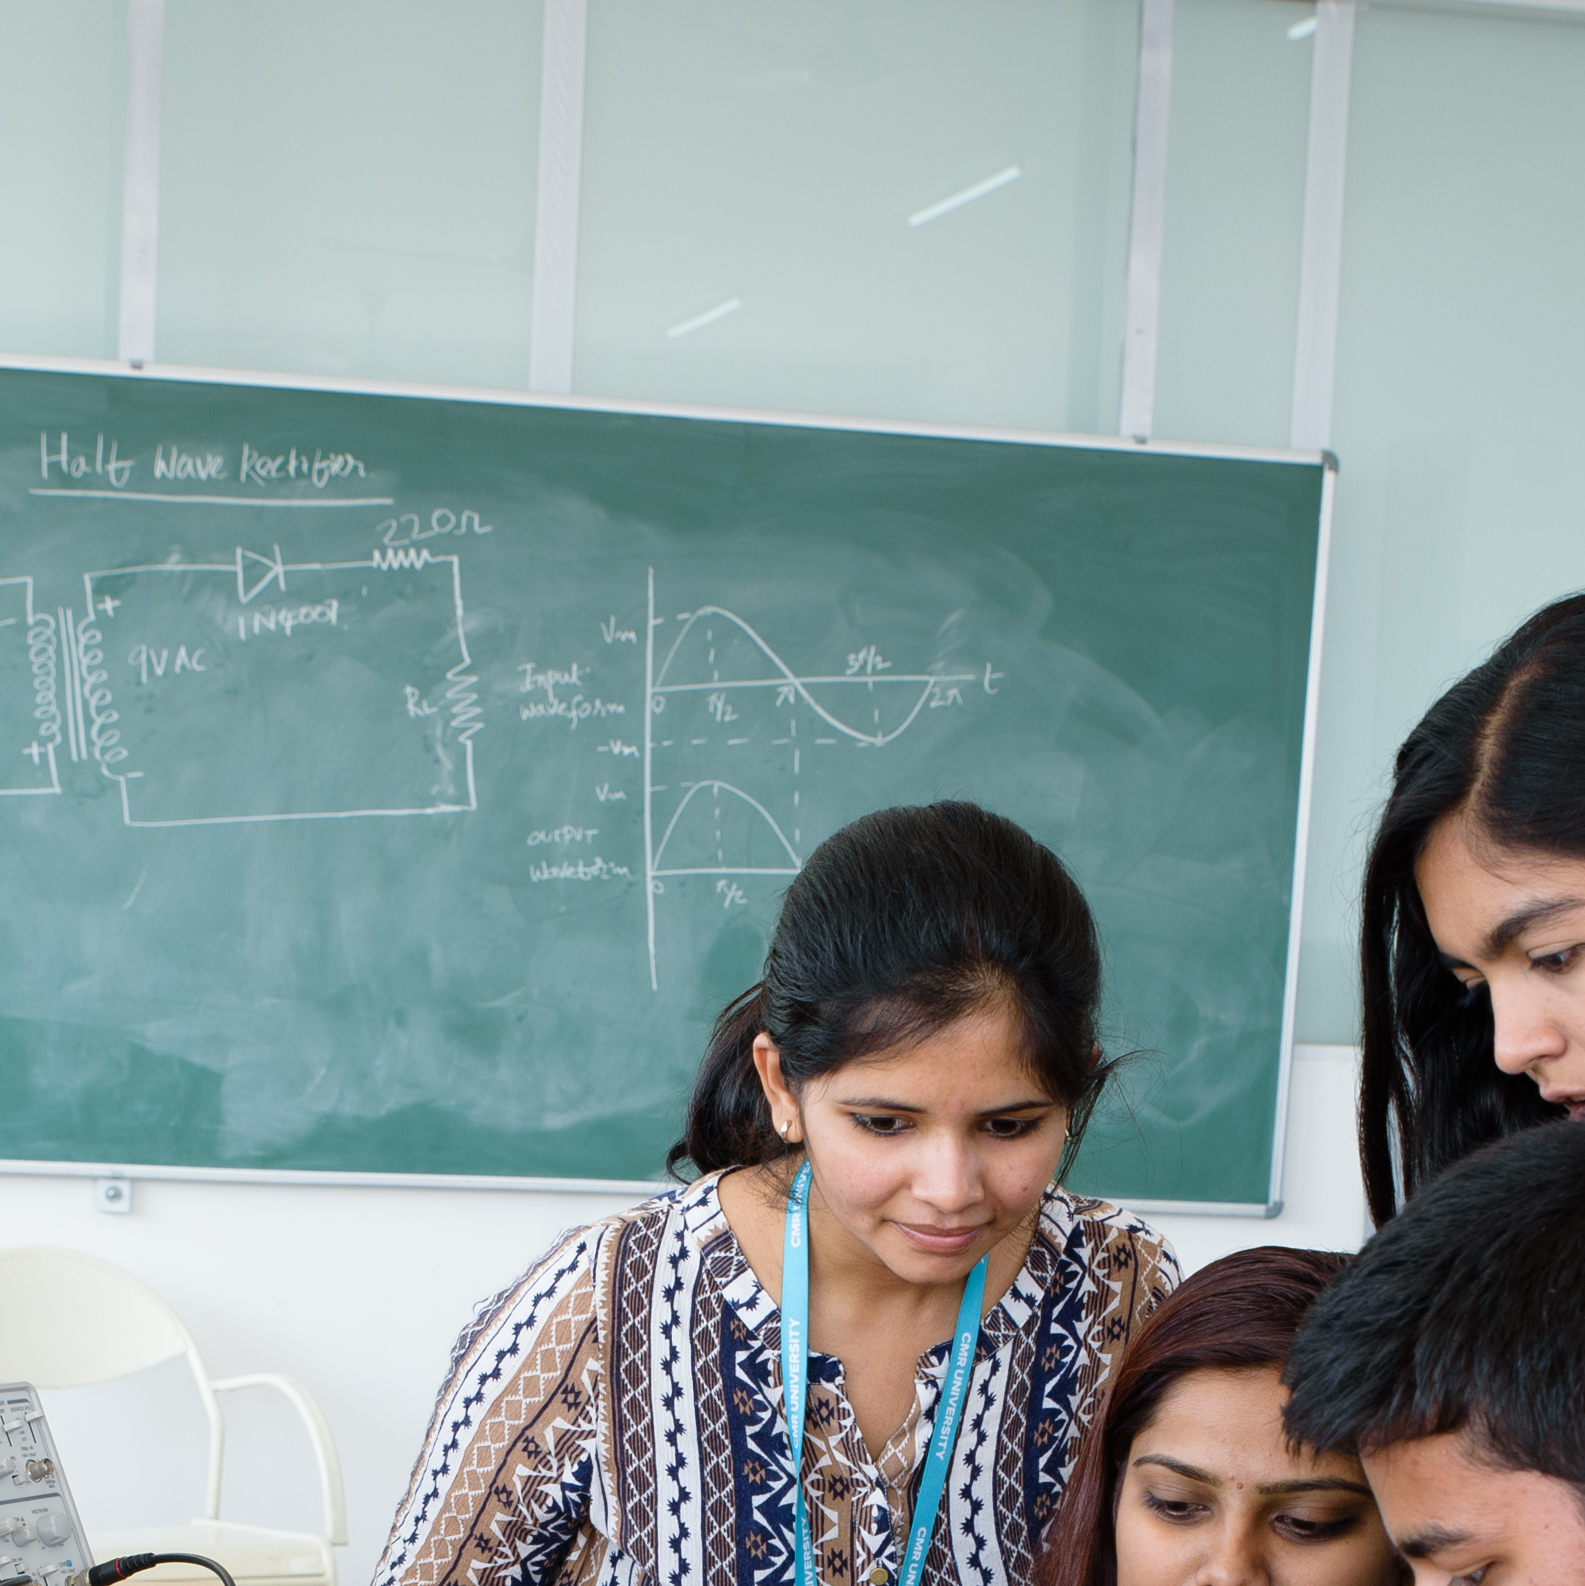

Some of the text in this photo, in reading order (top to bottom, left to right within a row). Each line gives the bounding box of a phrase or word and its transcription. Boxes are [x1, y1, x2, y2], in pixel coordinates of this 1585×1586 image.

[39, 431, 135, 488] Half
[790, 1211, 802, 1249] CMR
[788, 1317, 802, 1450] CMR UNIVERSITY
[935, 1331, 971, 1462] CMR UNIVERSITY
[910, 1525, 928, 1564] CMR
